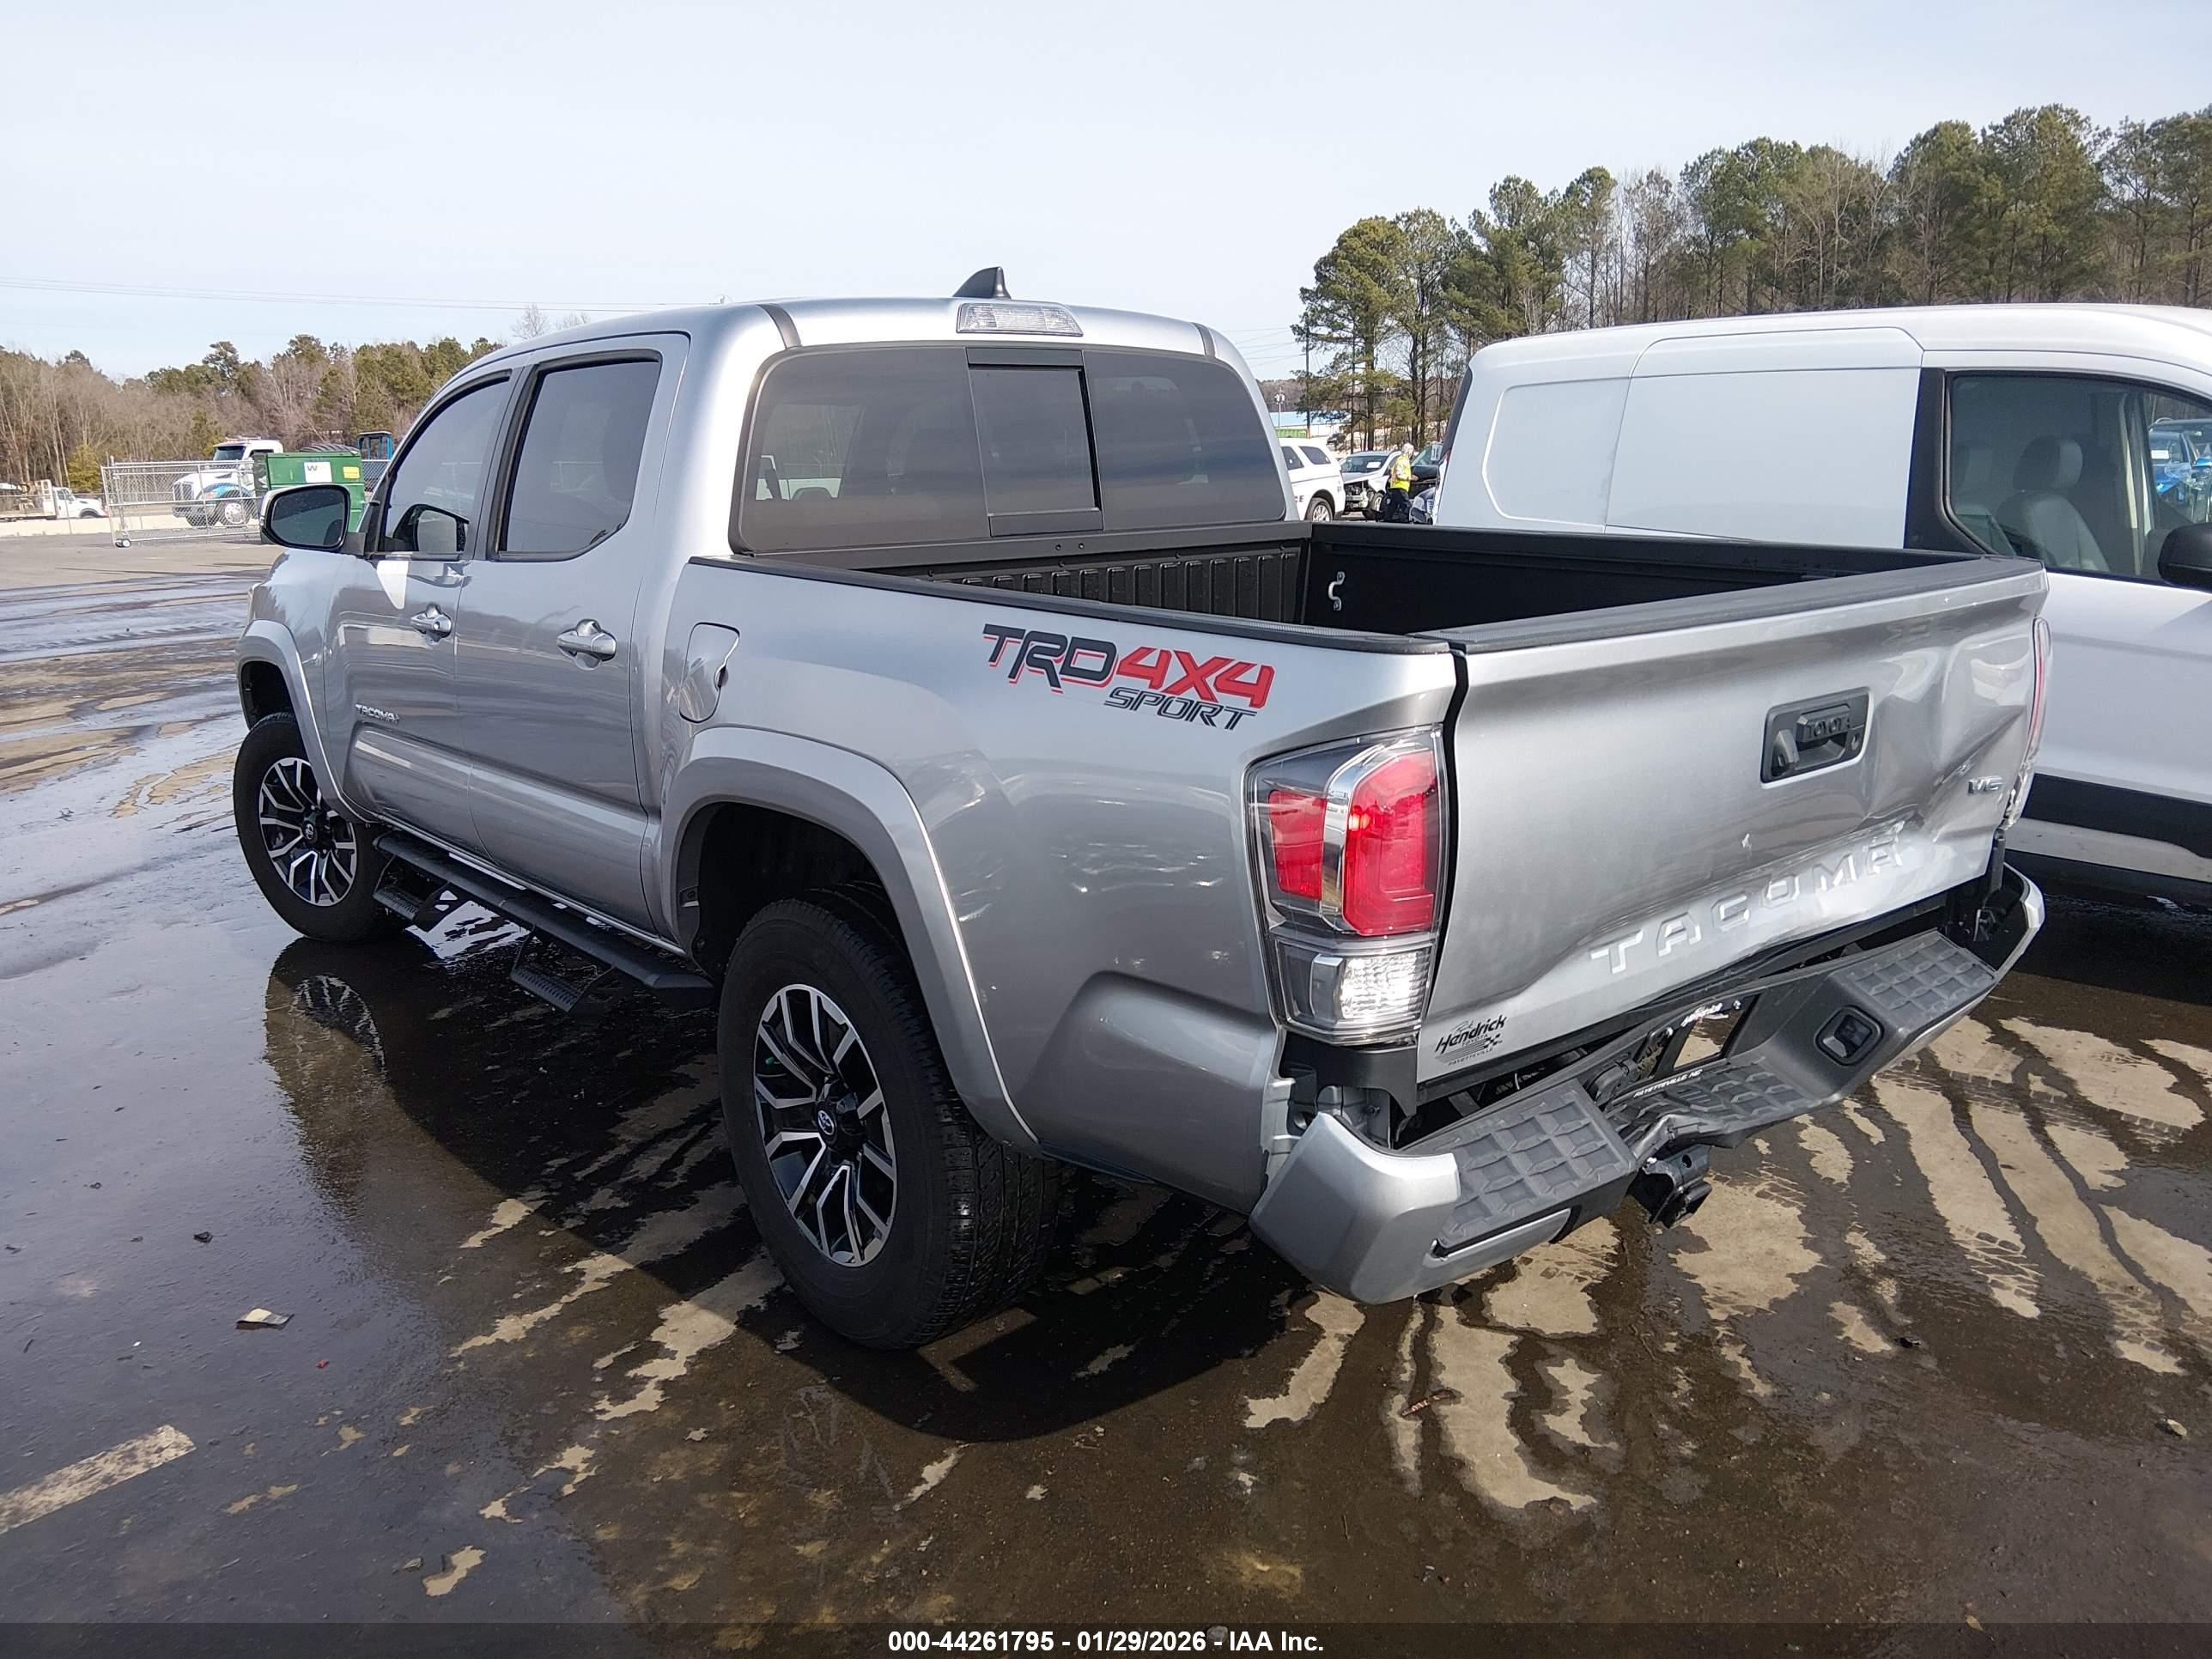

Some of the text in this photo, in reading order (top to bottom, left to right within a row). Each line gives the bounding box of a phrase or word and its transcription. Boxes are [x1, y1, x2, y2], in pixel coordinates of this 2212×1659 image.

[1103, 686, 1258, 731] SPORT
[1589, 833, 1904, 975] TACOMA
[1434, 1014, 1508, 1054] Hendrick
